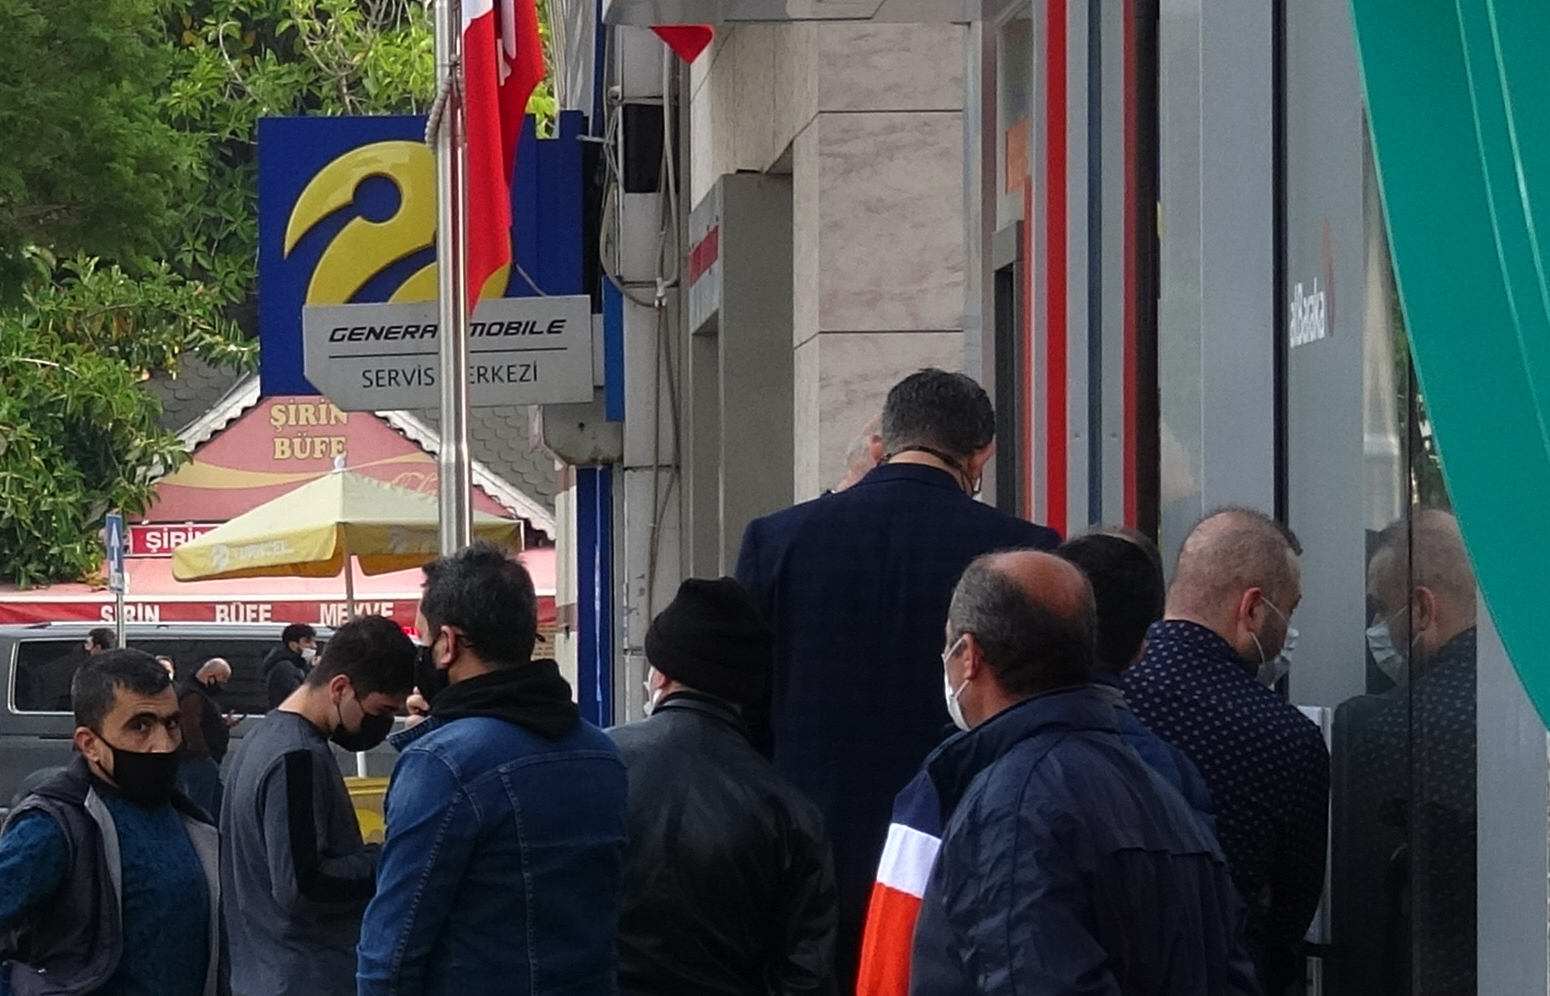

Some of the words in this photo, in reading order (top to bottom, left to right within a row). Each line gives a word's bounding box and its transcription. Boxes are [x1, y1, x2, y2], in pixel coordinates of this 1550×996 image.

[328, 324, 438, 343] GENERA
[361, 364, 436, 389] SERVİS
[270, 399, 348, 431] ŞİRİN
[273, 432, 348, 459] BÜFE
